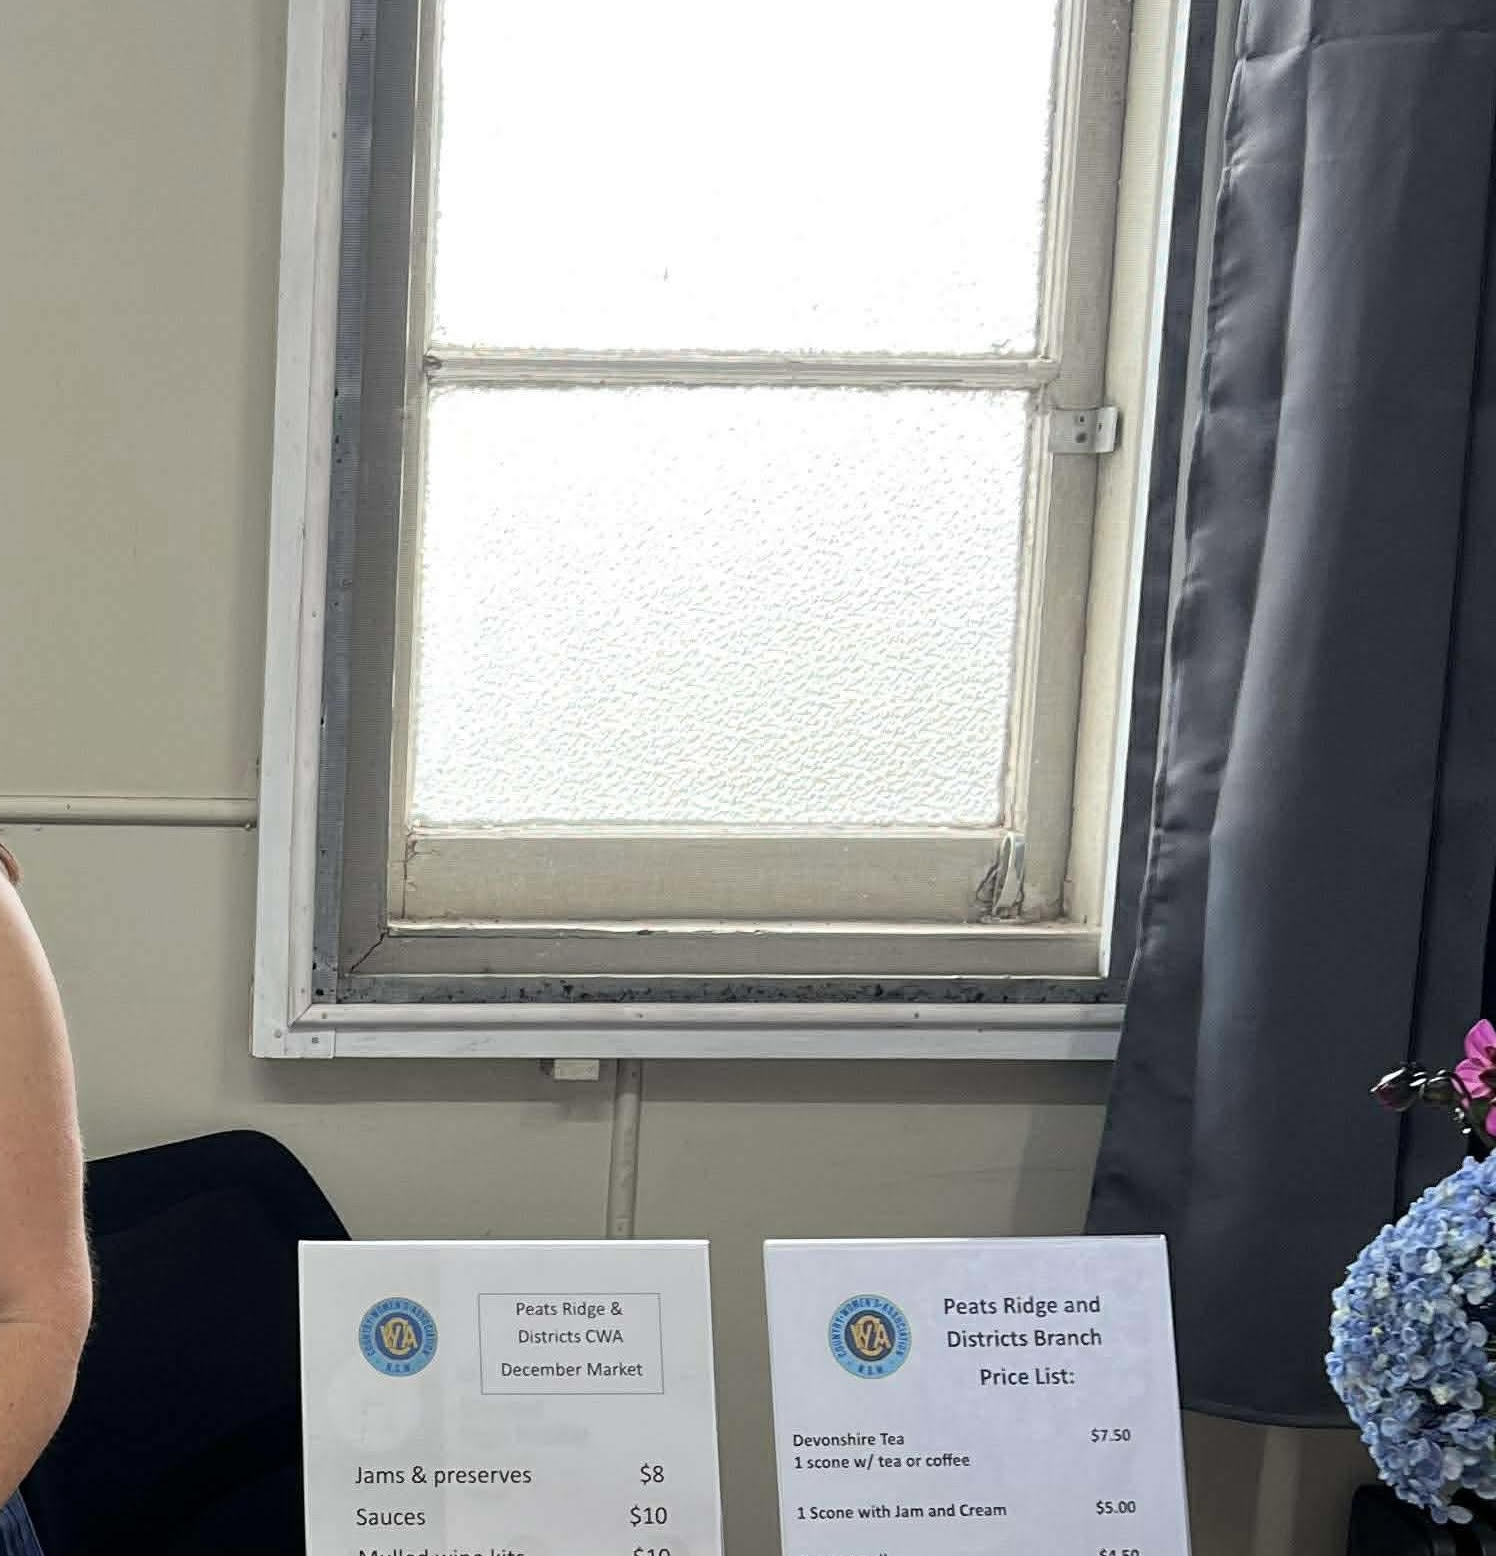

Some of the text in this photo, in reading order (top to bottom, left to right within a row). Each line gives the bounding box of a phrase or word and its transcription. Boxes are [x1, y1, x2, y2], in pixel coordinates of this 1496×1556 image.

[516, 1301, 624, 1319] Peats Ridge &
[943, 1295, 1101, 1318] Peats Ridge and
[518, 1329, 624, 1344] Districts CWA
[947, 1327, 1102, 1348] Districts Branch
[501, 1362, 643, 1377] December Market
[979, 1367, 1075, 1386] Price List:
[792, 1432, 905, 1447] Devonshire Tea
[1091, 1427, 1132, 1444] $7.50
[794, 1452, 971, 1471] 1 scone w/ tea or coffee
[354, 1465, 532, 1488] Jams & preserves
[640, 1462, 665, 1486] $8
[356, 1507, 426, 1526] Sauces
[629, 1504, 668, 1528] $10
[797, 1503, 1007, 1520] 1 Scone with Jam and Cream
[1095, 1500, 1137, 1516] $5.00
